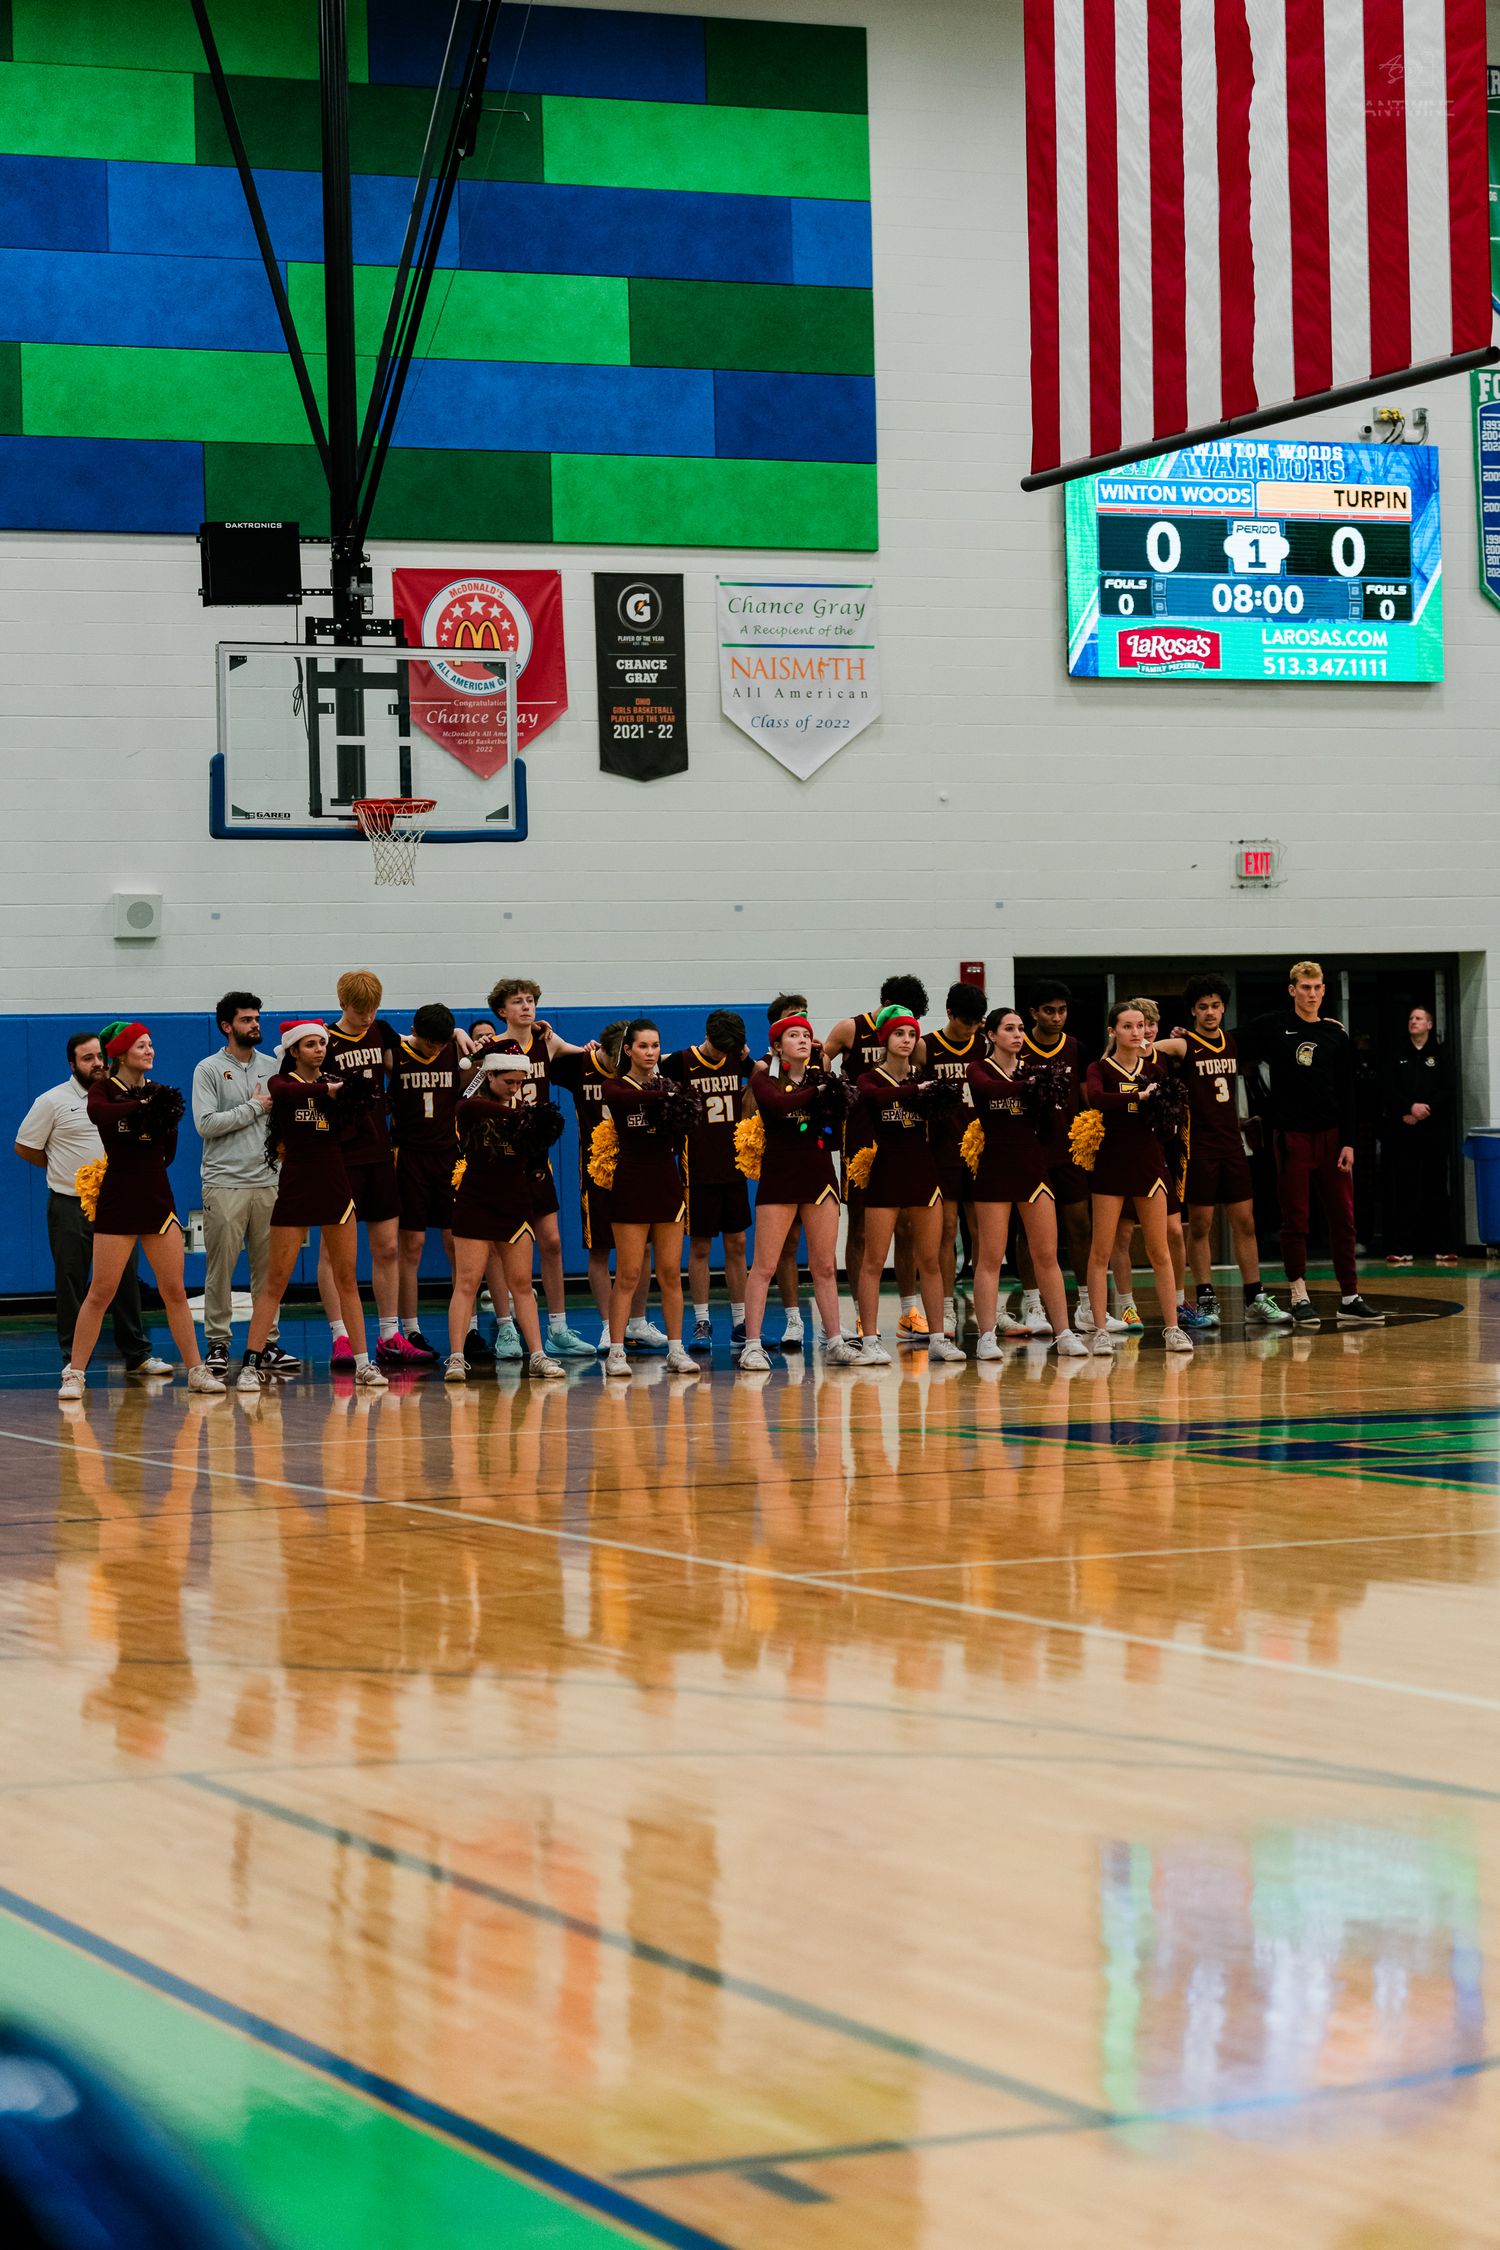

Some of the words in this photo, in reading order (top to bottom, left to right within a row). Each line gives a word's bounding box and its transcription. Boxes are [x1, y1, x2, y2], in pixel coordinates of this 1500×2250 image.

[1193, 442, 1270, 457] WINTON
[1277, 444, 1343, 460] WOODS
[1183, 453, 1345, 482] WARRIORS
[1100, 484, 1177, 502] WINTON
[1181, 486, 1251, 504] WOODS
[1333, 489, 1407, 509] TURPIN
[1236, 525, 1277, 534] PERIOD
[1146, 521, 1182, 574] 0
[1248, 539, 1267, 569] 1
[1331, 526, 1366, 578] 0
[1104, 578, 1148, 590] FOULS
[1366, 585, 1407, 595] FOULS
[728, 595, 804, 614] Chance
[813, 599, 865, 621] Gray
[1118, 593, 1135, 615] 0
[1212, 583, 1304, 614] 08:00
[1379, 599, 1395, 621] 0
[740, 625, 749, 635] A
[753, 624, 816, 638] Recipient
[818, 625, 832, 637] of
[834, 625, 856, 636] the
[1262, 628, 1388, 647] LAROSAS.COM
[616, 659, 668, 670] CHANCE
[1141, 664, 1167, 673] FAMILY
[1263, 657, 1387, 676] 513.347.1111
[436, 661, 449, 678] ALL
[450, 674, 496, 691] AMERICAN
[625, 672, 659, 684] GRAY
[732, 687, 762, 699] All
[774, 687, 869, 699] American
[453, 699, 508, 708] Congratulation
[612, 706, 632, 714] GIRLS
[633, 706, 674, 714] BASKETBALL
[426, 708, 489, 724] Chance
[496, 710, 539, 729] Gay
[611, 714, 635, 723] PLAYER
[636, 714, 645, 723] OF
[646, 714, 658, 723] THE
[660, 714, 676, 723] YEAR
[751, 714, 790, 729] Class
[795, 714, 813, 733] of
[815, 719, 851, 729] 2022
[613, 724, 645, 739] 2021
[657, 724, 674, 739] 22
[256, 811, 291, 819] GARED
[1245, 852, 1271, 876] EXIT
[334, 1047, 383, 1070] TURPIN
[1195, 1058, 1237, 1076] TURPIN
[399, 1071, 453, 1089] TURPIN
[934, 1062, 969, 1079] TUR
[690, 1074, 739, 1093] TURPIN
[1214, 1077, 1230, 1103] 3
[422, 1091, 434, 1118] 1
[705, 1095, 735, 1123] 21
